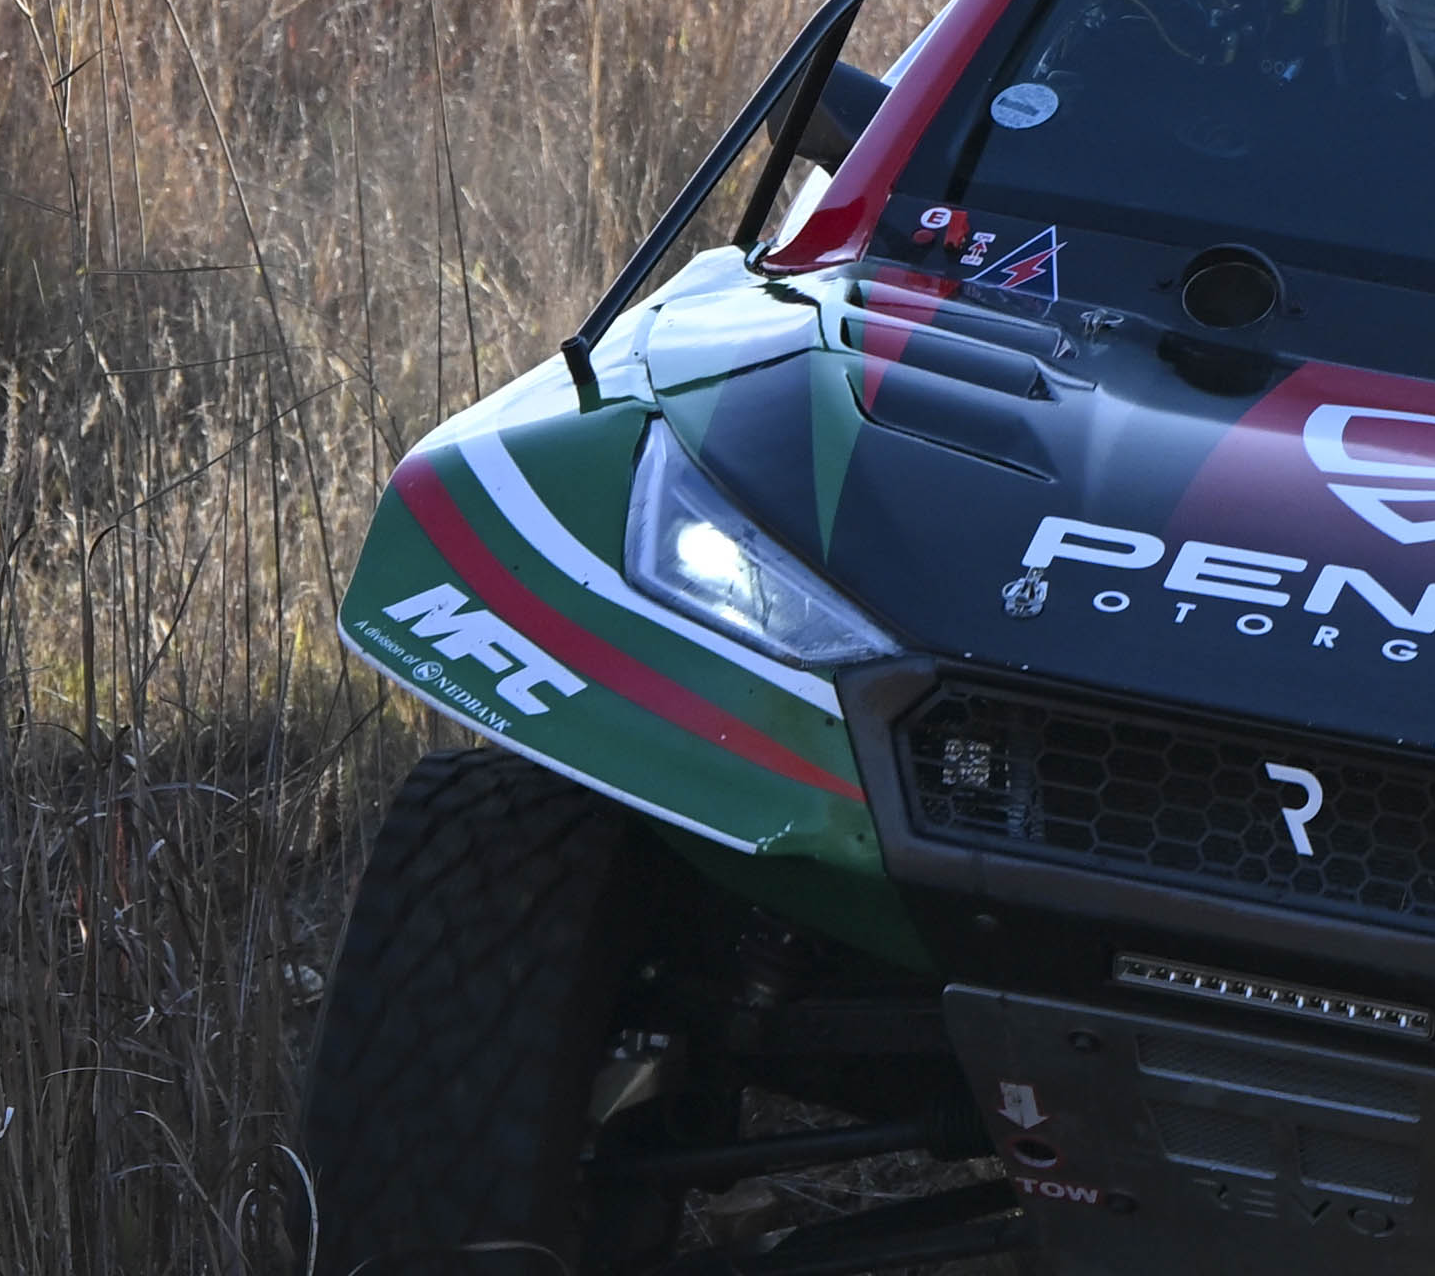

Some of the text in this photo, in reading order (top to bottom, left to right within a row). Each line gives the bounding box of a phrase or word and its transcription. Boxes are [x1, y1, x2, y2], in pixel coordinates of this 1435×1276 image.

[927, 211, 947, 225] E
[353, 620, 513, 733] A division of NEDBANK
[381, 582, 588, 715] MFC
[1015, 1176, 1099, 1204] TOW
